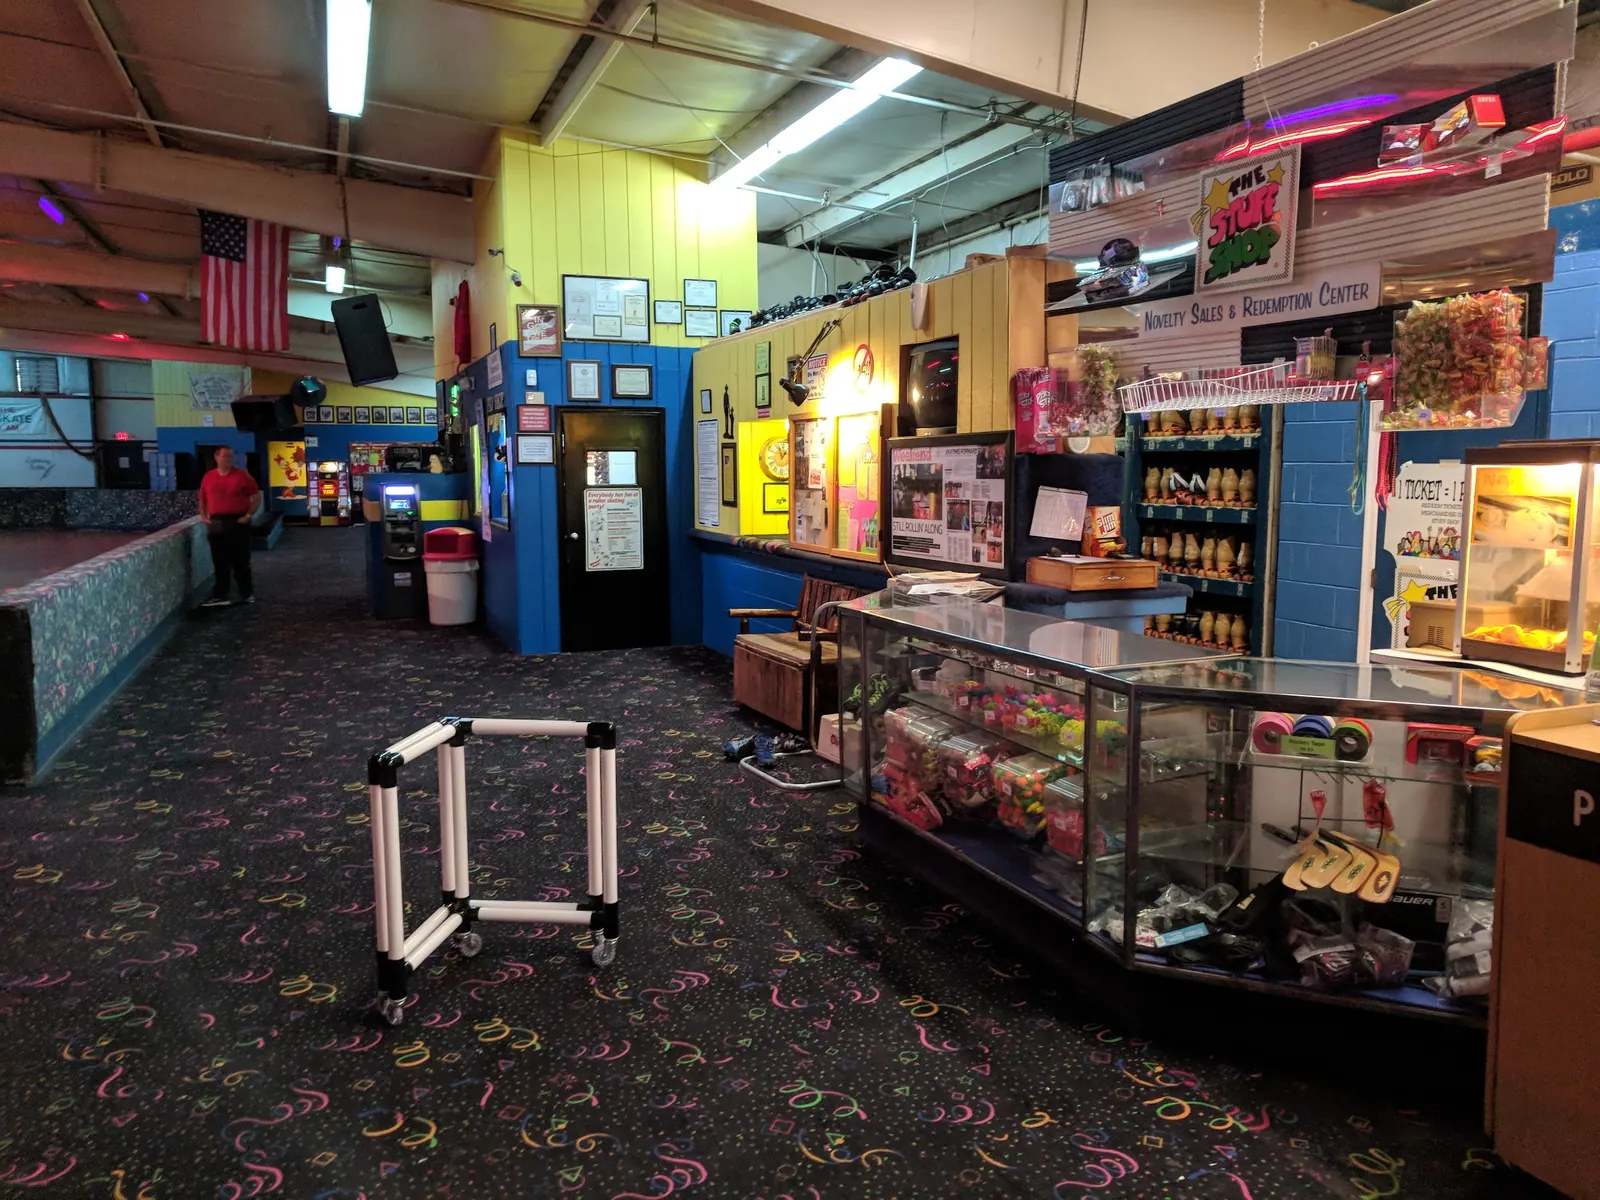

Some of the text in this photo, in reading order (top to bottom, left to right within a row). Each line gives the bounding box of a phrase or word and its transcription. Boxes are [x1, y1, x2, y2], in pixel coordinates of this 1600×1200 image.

[1229, 164, 1265, 197] THE
[1208, 182, 1279, 249] STUFF
[1204, 223, 1281, 284] SHOP
[1144, 281, 1369, 332] NOVELTY SALES & REDEMPTION CENTER
[808, 357, 827, 369] NOTICE
[1405, 479, 1443, 501] TICKET
[1444, 488, 1449, 496] =
[893, 521, 905, 531] STILL
[924, 523, 943, 535] ALONG
[1425, 584, 1458, 601] THE
[1573, 788, 1595, 826] P
[1390, 895, 1434, 906] AUER
